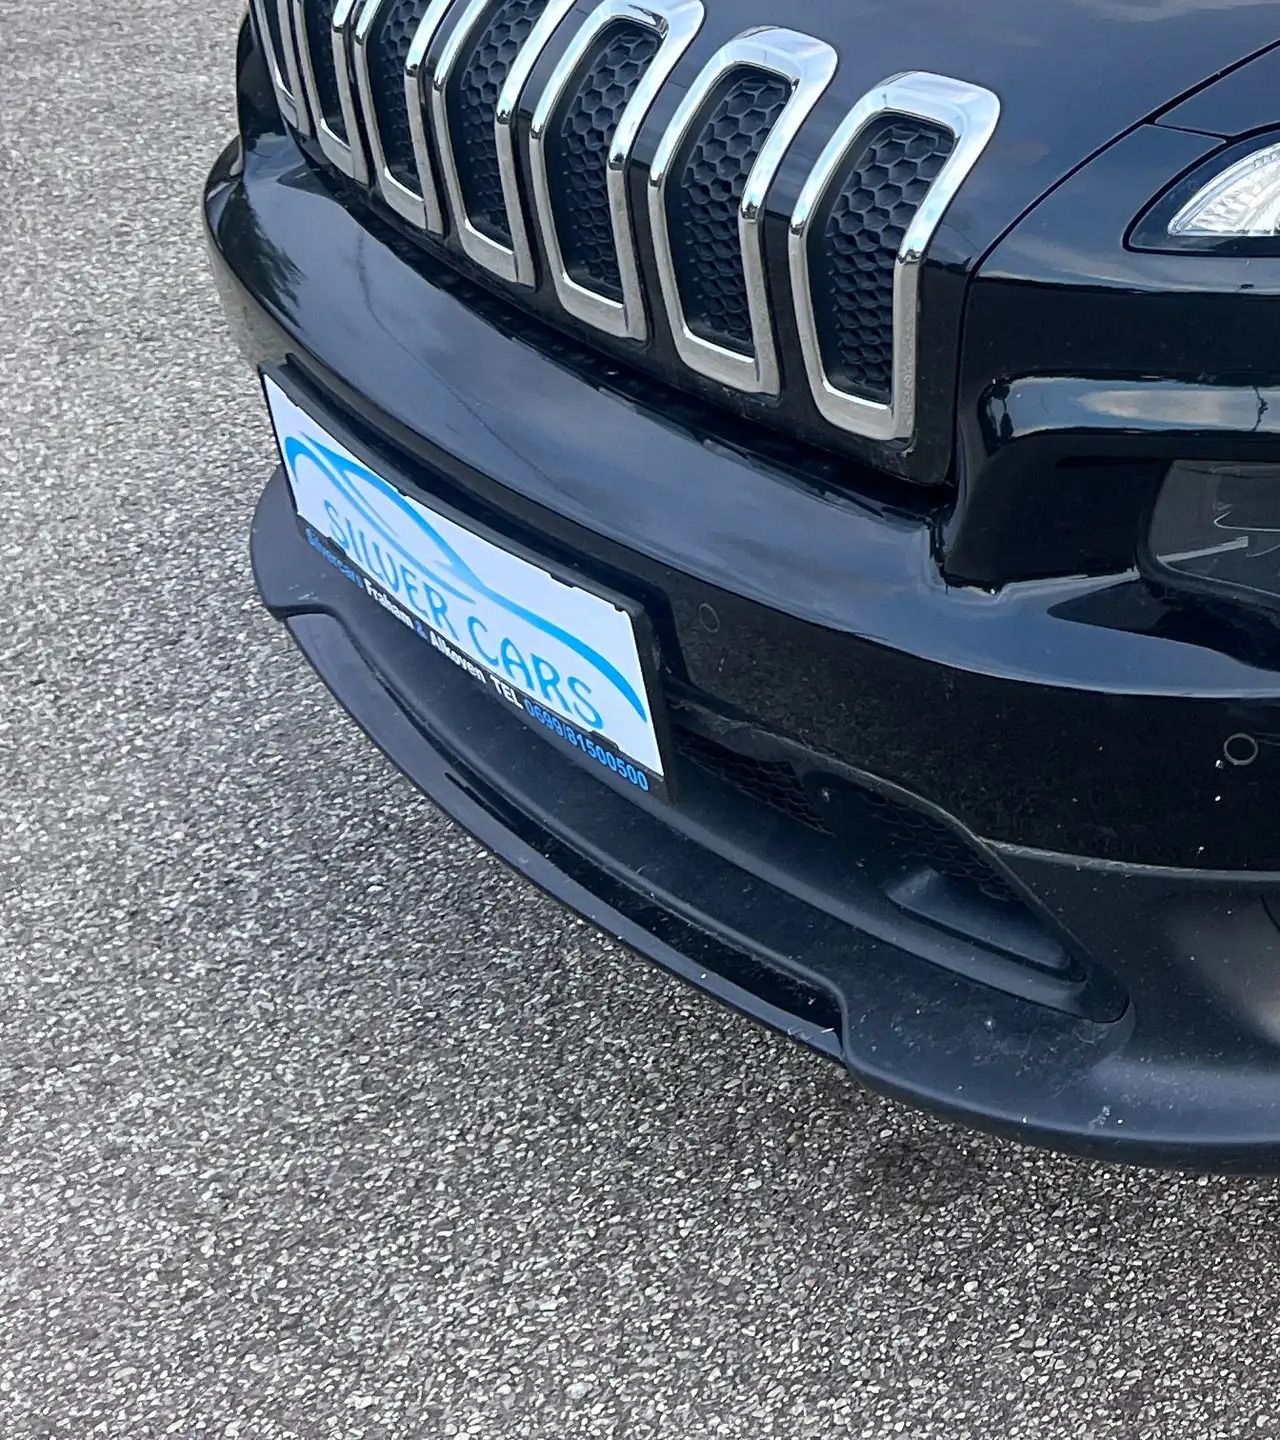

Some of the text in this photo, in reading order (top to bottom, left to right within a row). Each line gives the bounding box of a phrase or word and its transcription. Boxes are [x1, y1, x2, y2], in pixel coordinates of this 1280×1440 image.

[323, 498, 604, 731] SILVER CARS
[430, 630, 487, 685] Alkoven
[489, 674, 525, 710] TEL
[523, 697, 649, 792] 0699/81500500
